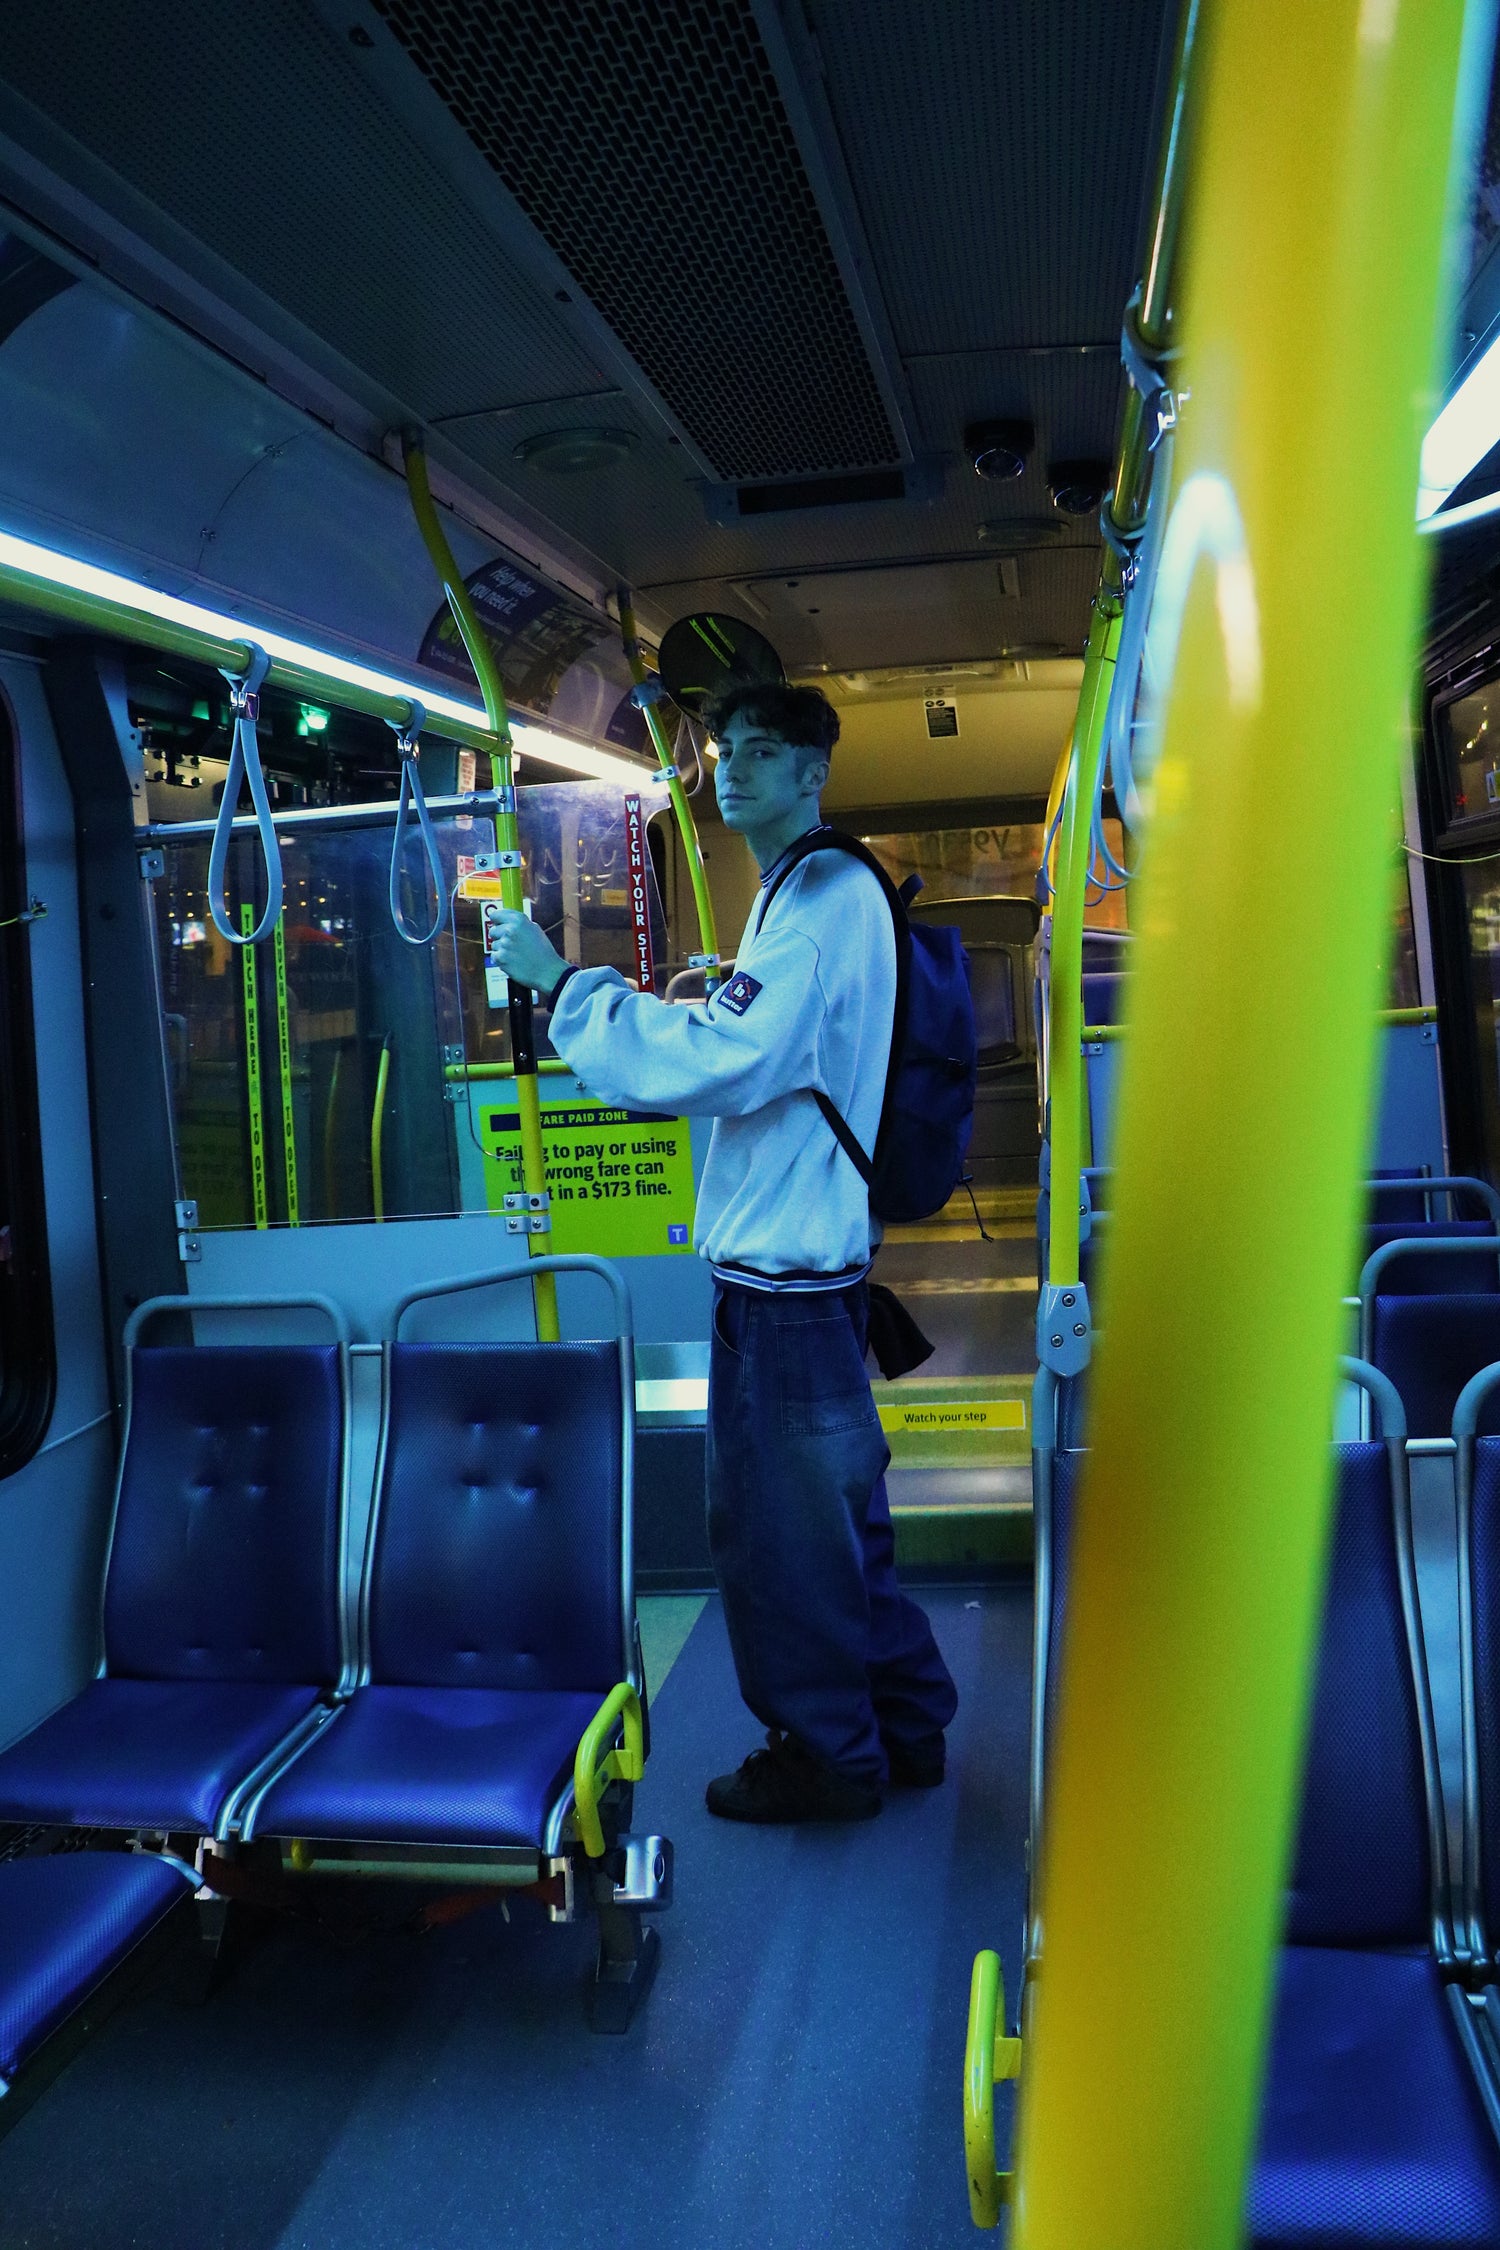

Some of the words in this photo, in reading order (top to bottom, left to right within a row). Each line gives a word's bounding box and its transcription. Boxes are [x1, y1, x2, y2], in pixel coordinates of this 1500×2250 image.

[626, 800, 641, 867] WATCH
[632, 873, 645, 927] YOUR
[637, 933, 650, 986] STEP
[568, 1113, 595, 1123] PAID
[599, 1111, 628, 1121] ZONE
[496, 1145, 549, 1162] Failg
[552, 1144, 570, 1159] to
[575, 1144, 604, 1160] pay
[609, 1143, 626, 1155] or
[631, 1137, 677, 1156] using
[544, 1165, 594, 1181] wrong
[598, 1160, 630, 1177] fare
[634, 1162, 664, 1175] can
[558, 1184, 574, 1200] in
[578, 1187, 588, 1199] a
[591, 1180, 631, 1199] $173
[635, 1179, 672, 1196] fine.
[672, 1228, 683, 1242] T
[904, 1412, 936, 1423] Watch
[939, 1413, 961, 1424] your
[964, 1412, 987, 1422] step
